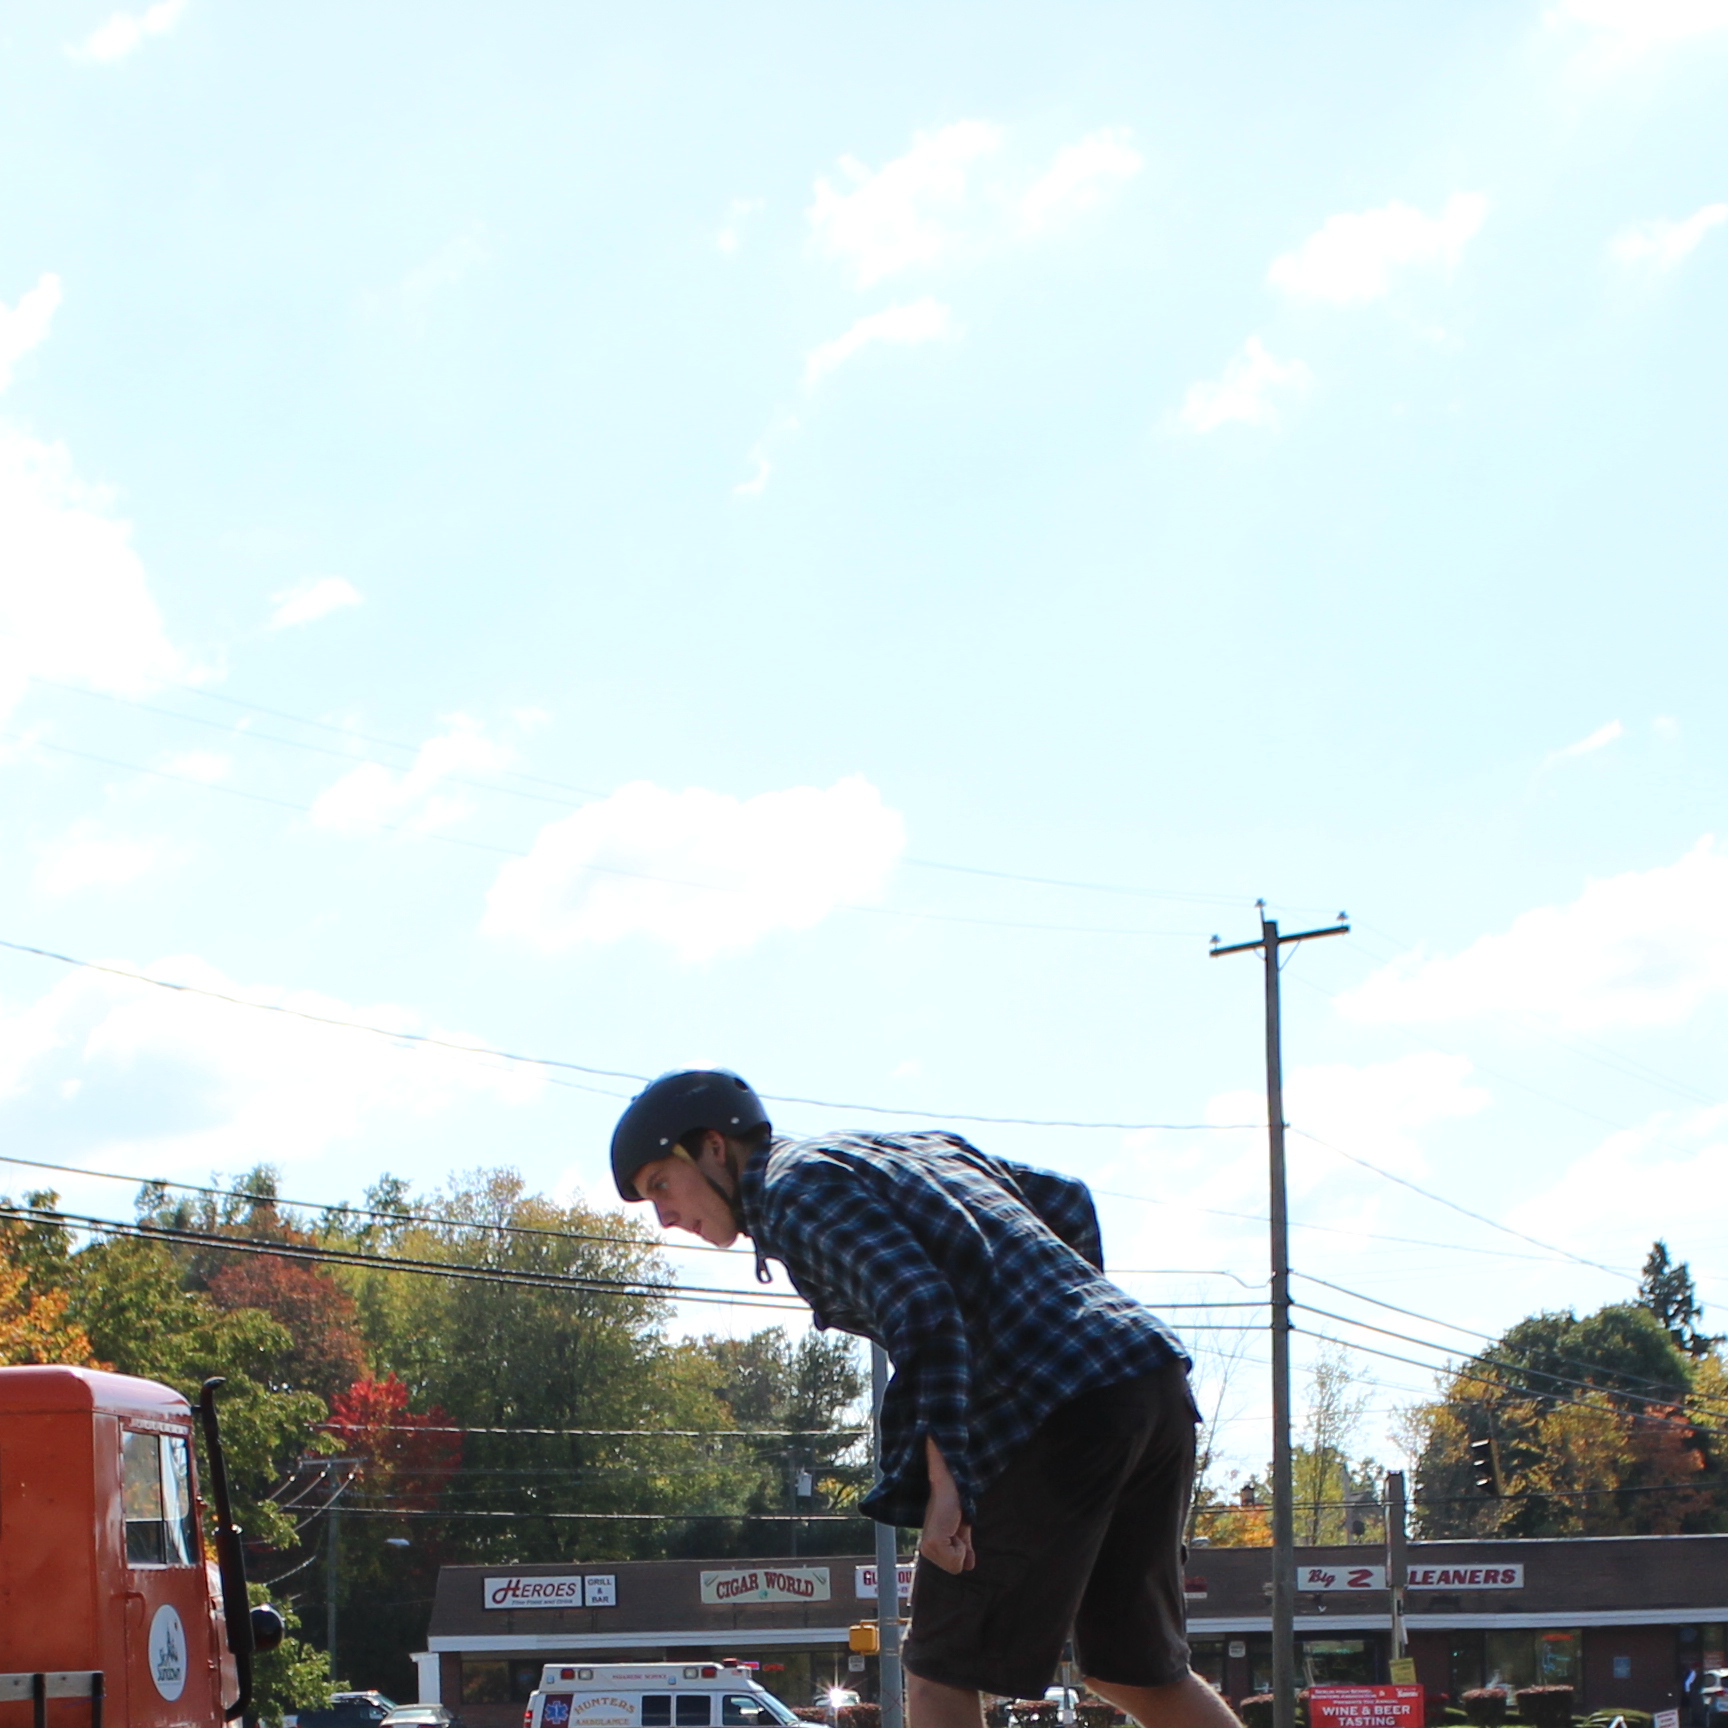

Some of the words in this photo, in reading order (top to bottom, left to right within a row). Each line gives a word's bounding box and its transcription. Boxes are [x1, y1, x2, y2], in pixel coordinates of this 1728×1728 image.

[716, 1573, 759, 1599] CIGAR
[764, 1572, 814, 1598] WORLD
[1308, 1568, 1336, 1588] Big
[1408, 1568, 1516, 1586] LEANERS
[492, 1579, 577, 1604] HEROES
[574, 1697, 636, 1715] HUNTERS
[1322, 1706, 1358, 1716] WINE
[1361, 1706, 1371, 1715] &
[1374, 1705, 1411, 1715] BEER
[1338, 1717, 1395, 1726] TASTING
